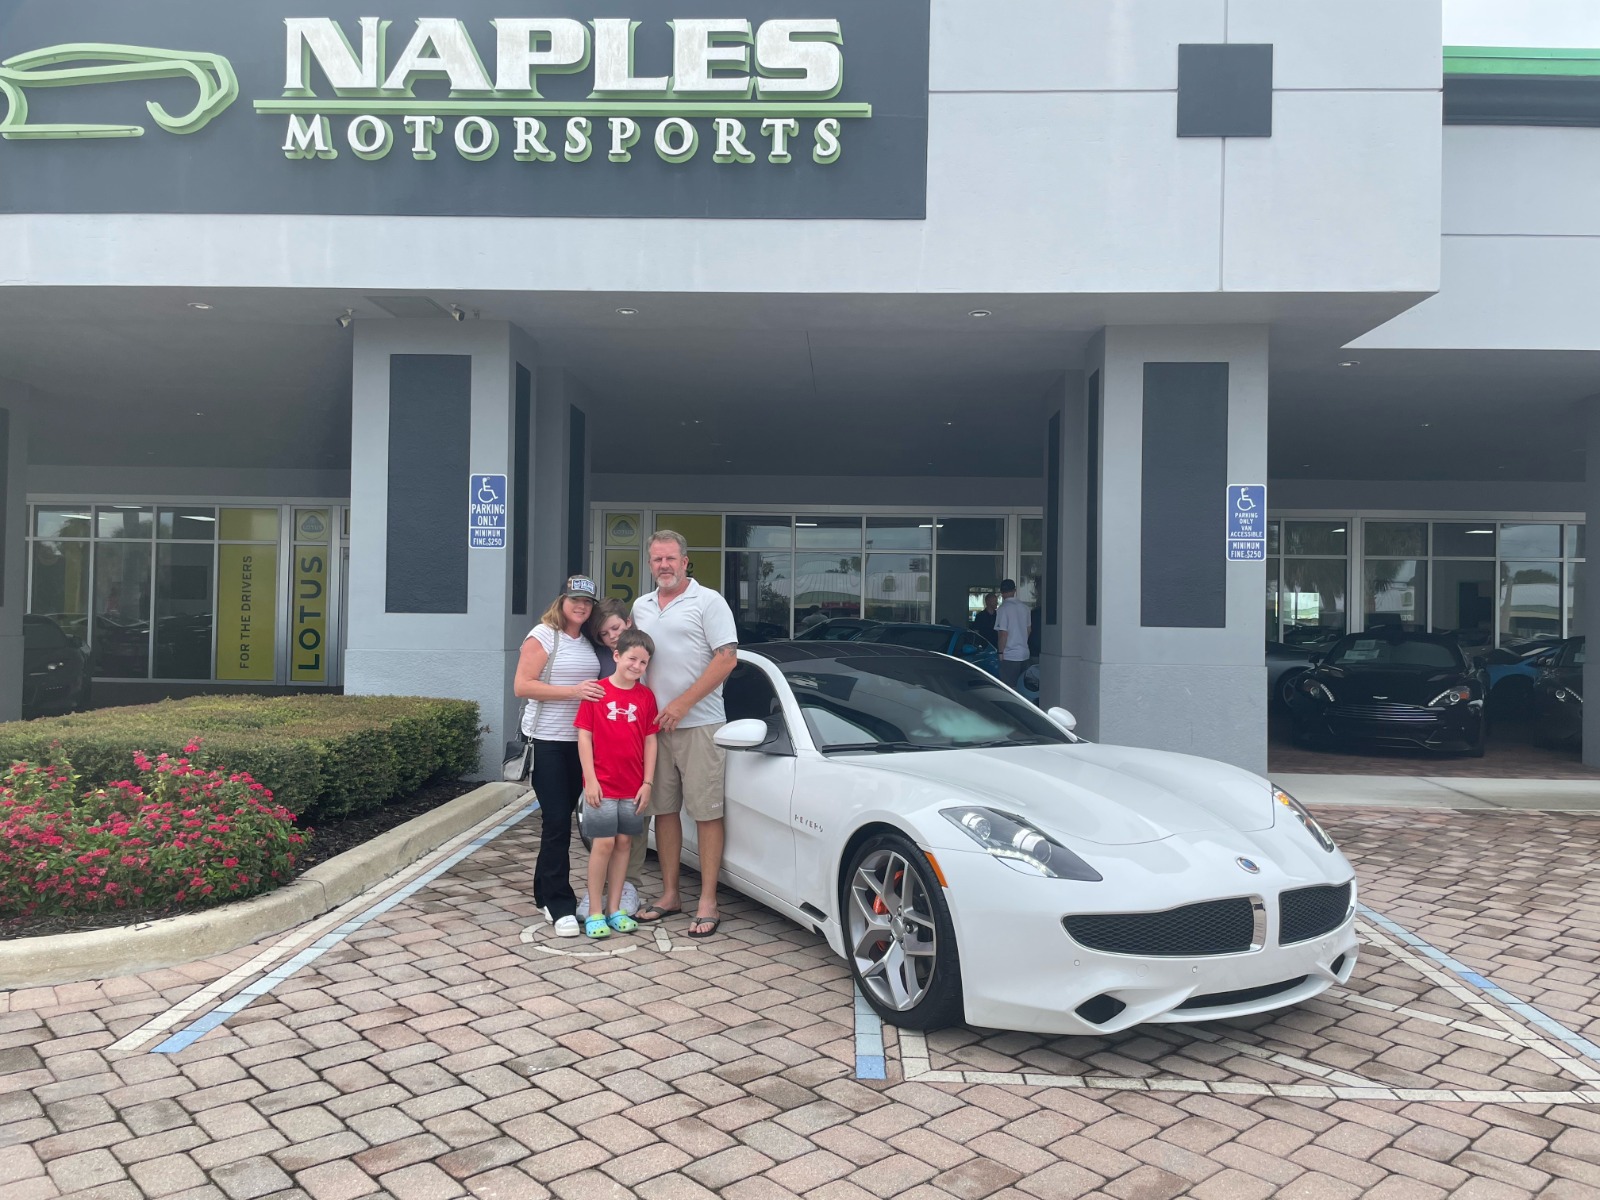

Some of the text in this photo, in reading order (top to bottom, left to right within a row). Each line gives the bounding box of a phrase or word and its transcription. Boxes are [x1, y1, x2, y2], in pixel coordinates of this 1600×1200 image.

[282, 16, 843, 97] NAPLES
[281, 112, 841, 163] MOTORSPORTS
[471, 503, 505, 514] PARKING
[477, 515, 499, 526] ONLY
[474, 529, 501, 537] MINIMUM
[487, 537, 502, 546] $250
[1232, 541, 1260, 549] MINIMUM
[1230, 550, 1262, 558] FINE $250
[240, 555, 252, 669] FOR THE DRIVERS
[298, 556, 323, 670] LOTUS
